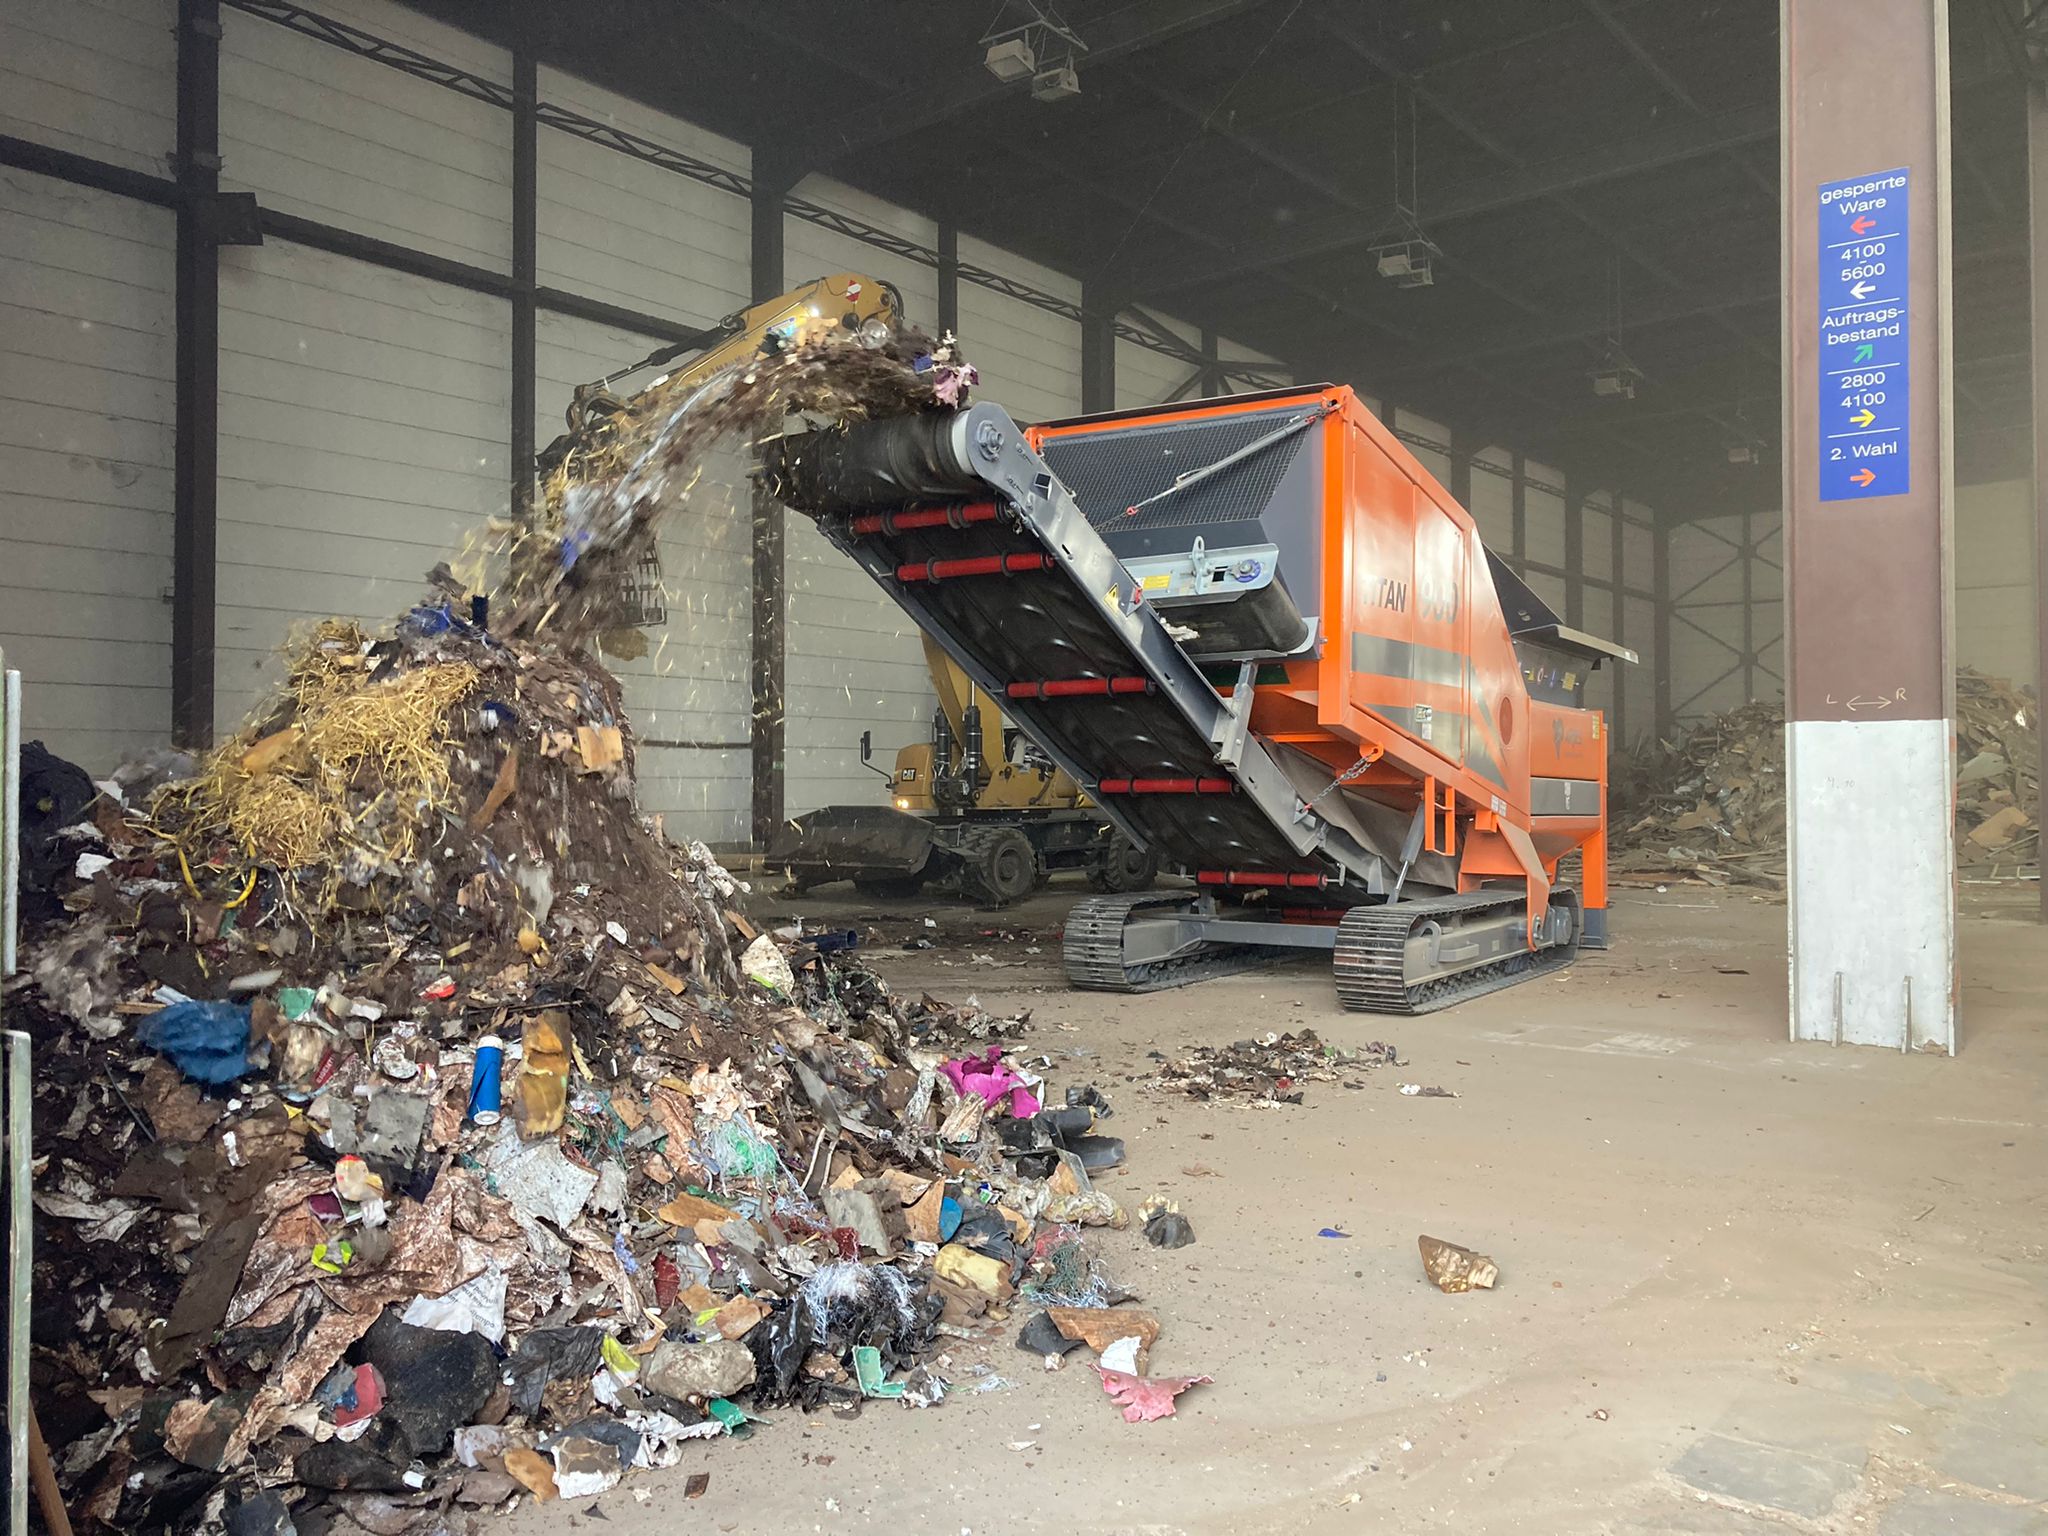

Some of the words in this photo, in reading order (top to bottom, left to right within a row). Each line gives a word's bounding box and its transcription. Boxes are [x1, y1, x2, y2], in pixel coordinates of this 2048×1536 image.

[1821, 176, 1906, 204] gesperrte
[1839, 198, 1886, 215] Ware
[1841, 243, 1886, 261] 4100
[1841, 263, 1886, 281] 5600
[1822, 307, 1905, 328] Auftrags-
[1827, 323, 1900, 345] bestand
[1841, 372, 1886, 389] 2800
[1841, 392, 1886, 408] 4100
[1830, 448, 1847, 461] 2.
[1852, 441, 1898, 459] Wahl
[1826, 693, 1839, 704] L
[1895, 687, 1908, 701] R
[902, 769, 916, 781] CAT
